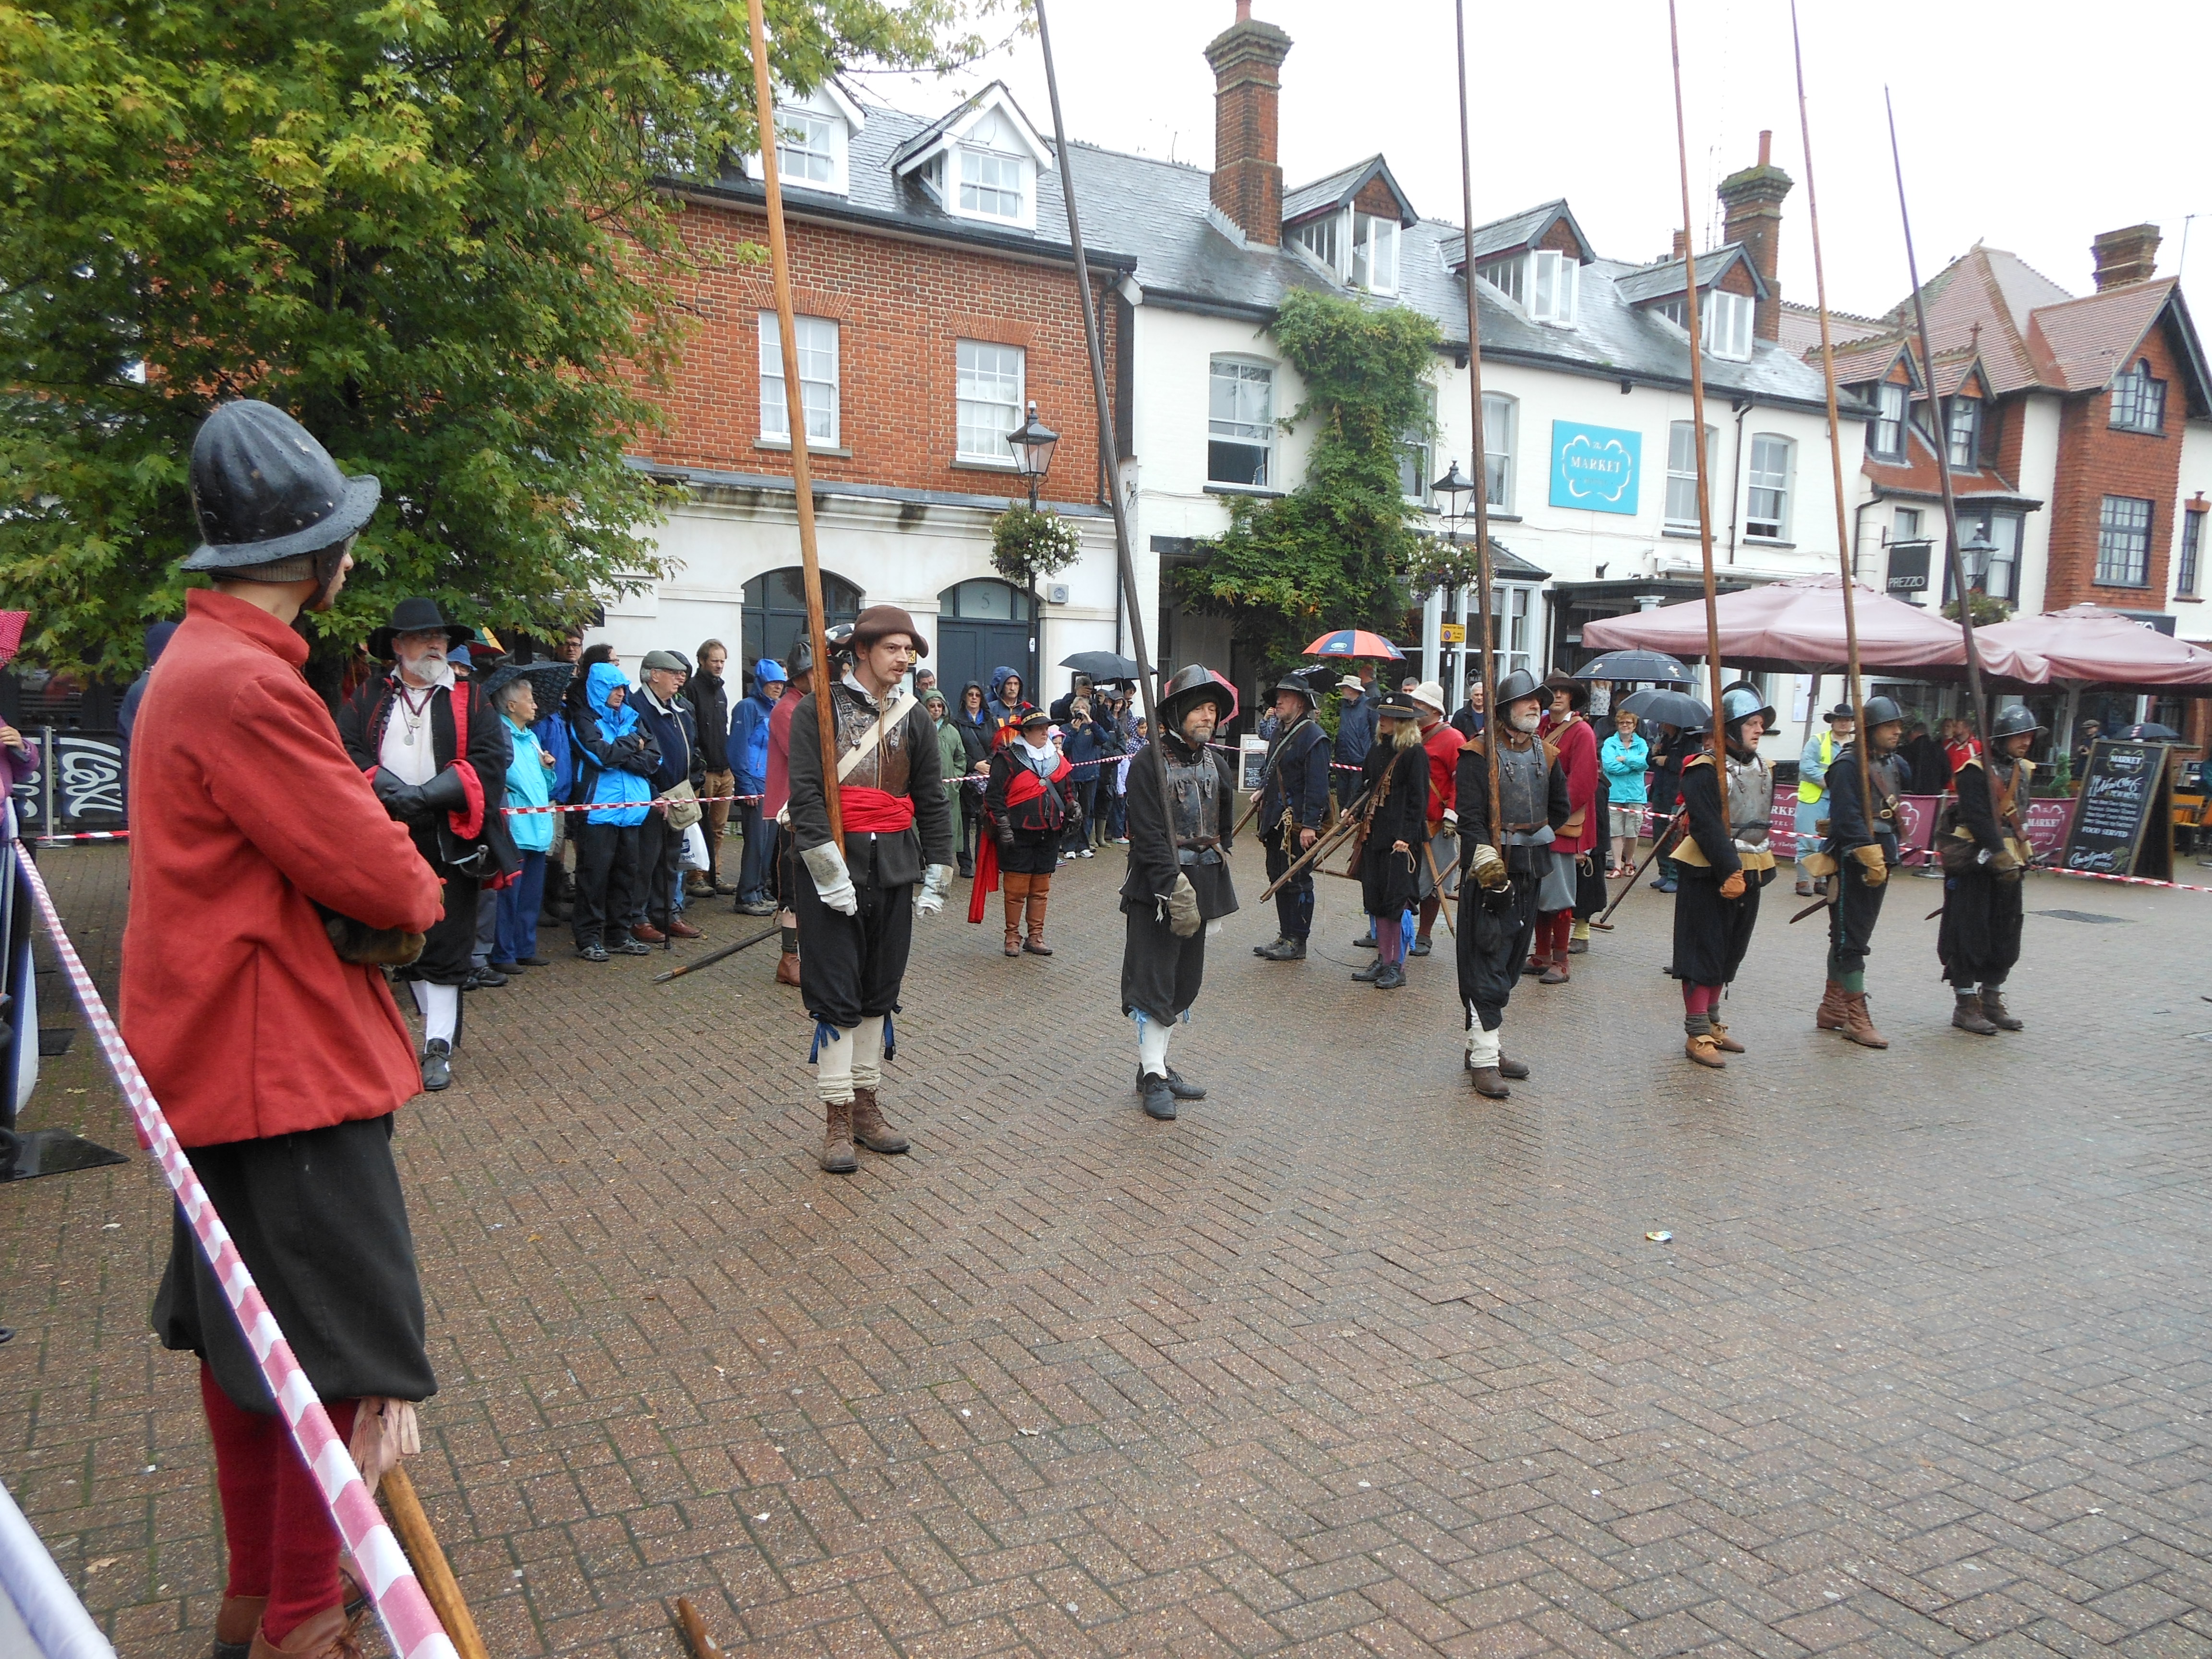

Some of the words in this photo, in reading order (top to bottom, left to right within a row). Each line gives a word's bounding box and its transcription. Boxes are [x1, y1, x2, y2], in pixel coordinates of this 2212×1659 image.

[1570, 456, 1620, 473] MARKET
[1887, 576, 1925, 588] PREZZO
[981, 592, 990, 609] 5
[2110, 755, 2142, 764] MARKET
[2116, 777, 2143, 793] Chef
[1770, 805, 1796, 816] RKE
[2102, 829, 2128, 838] SERVED
